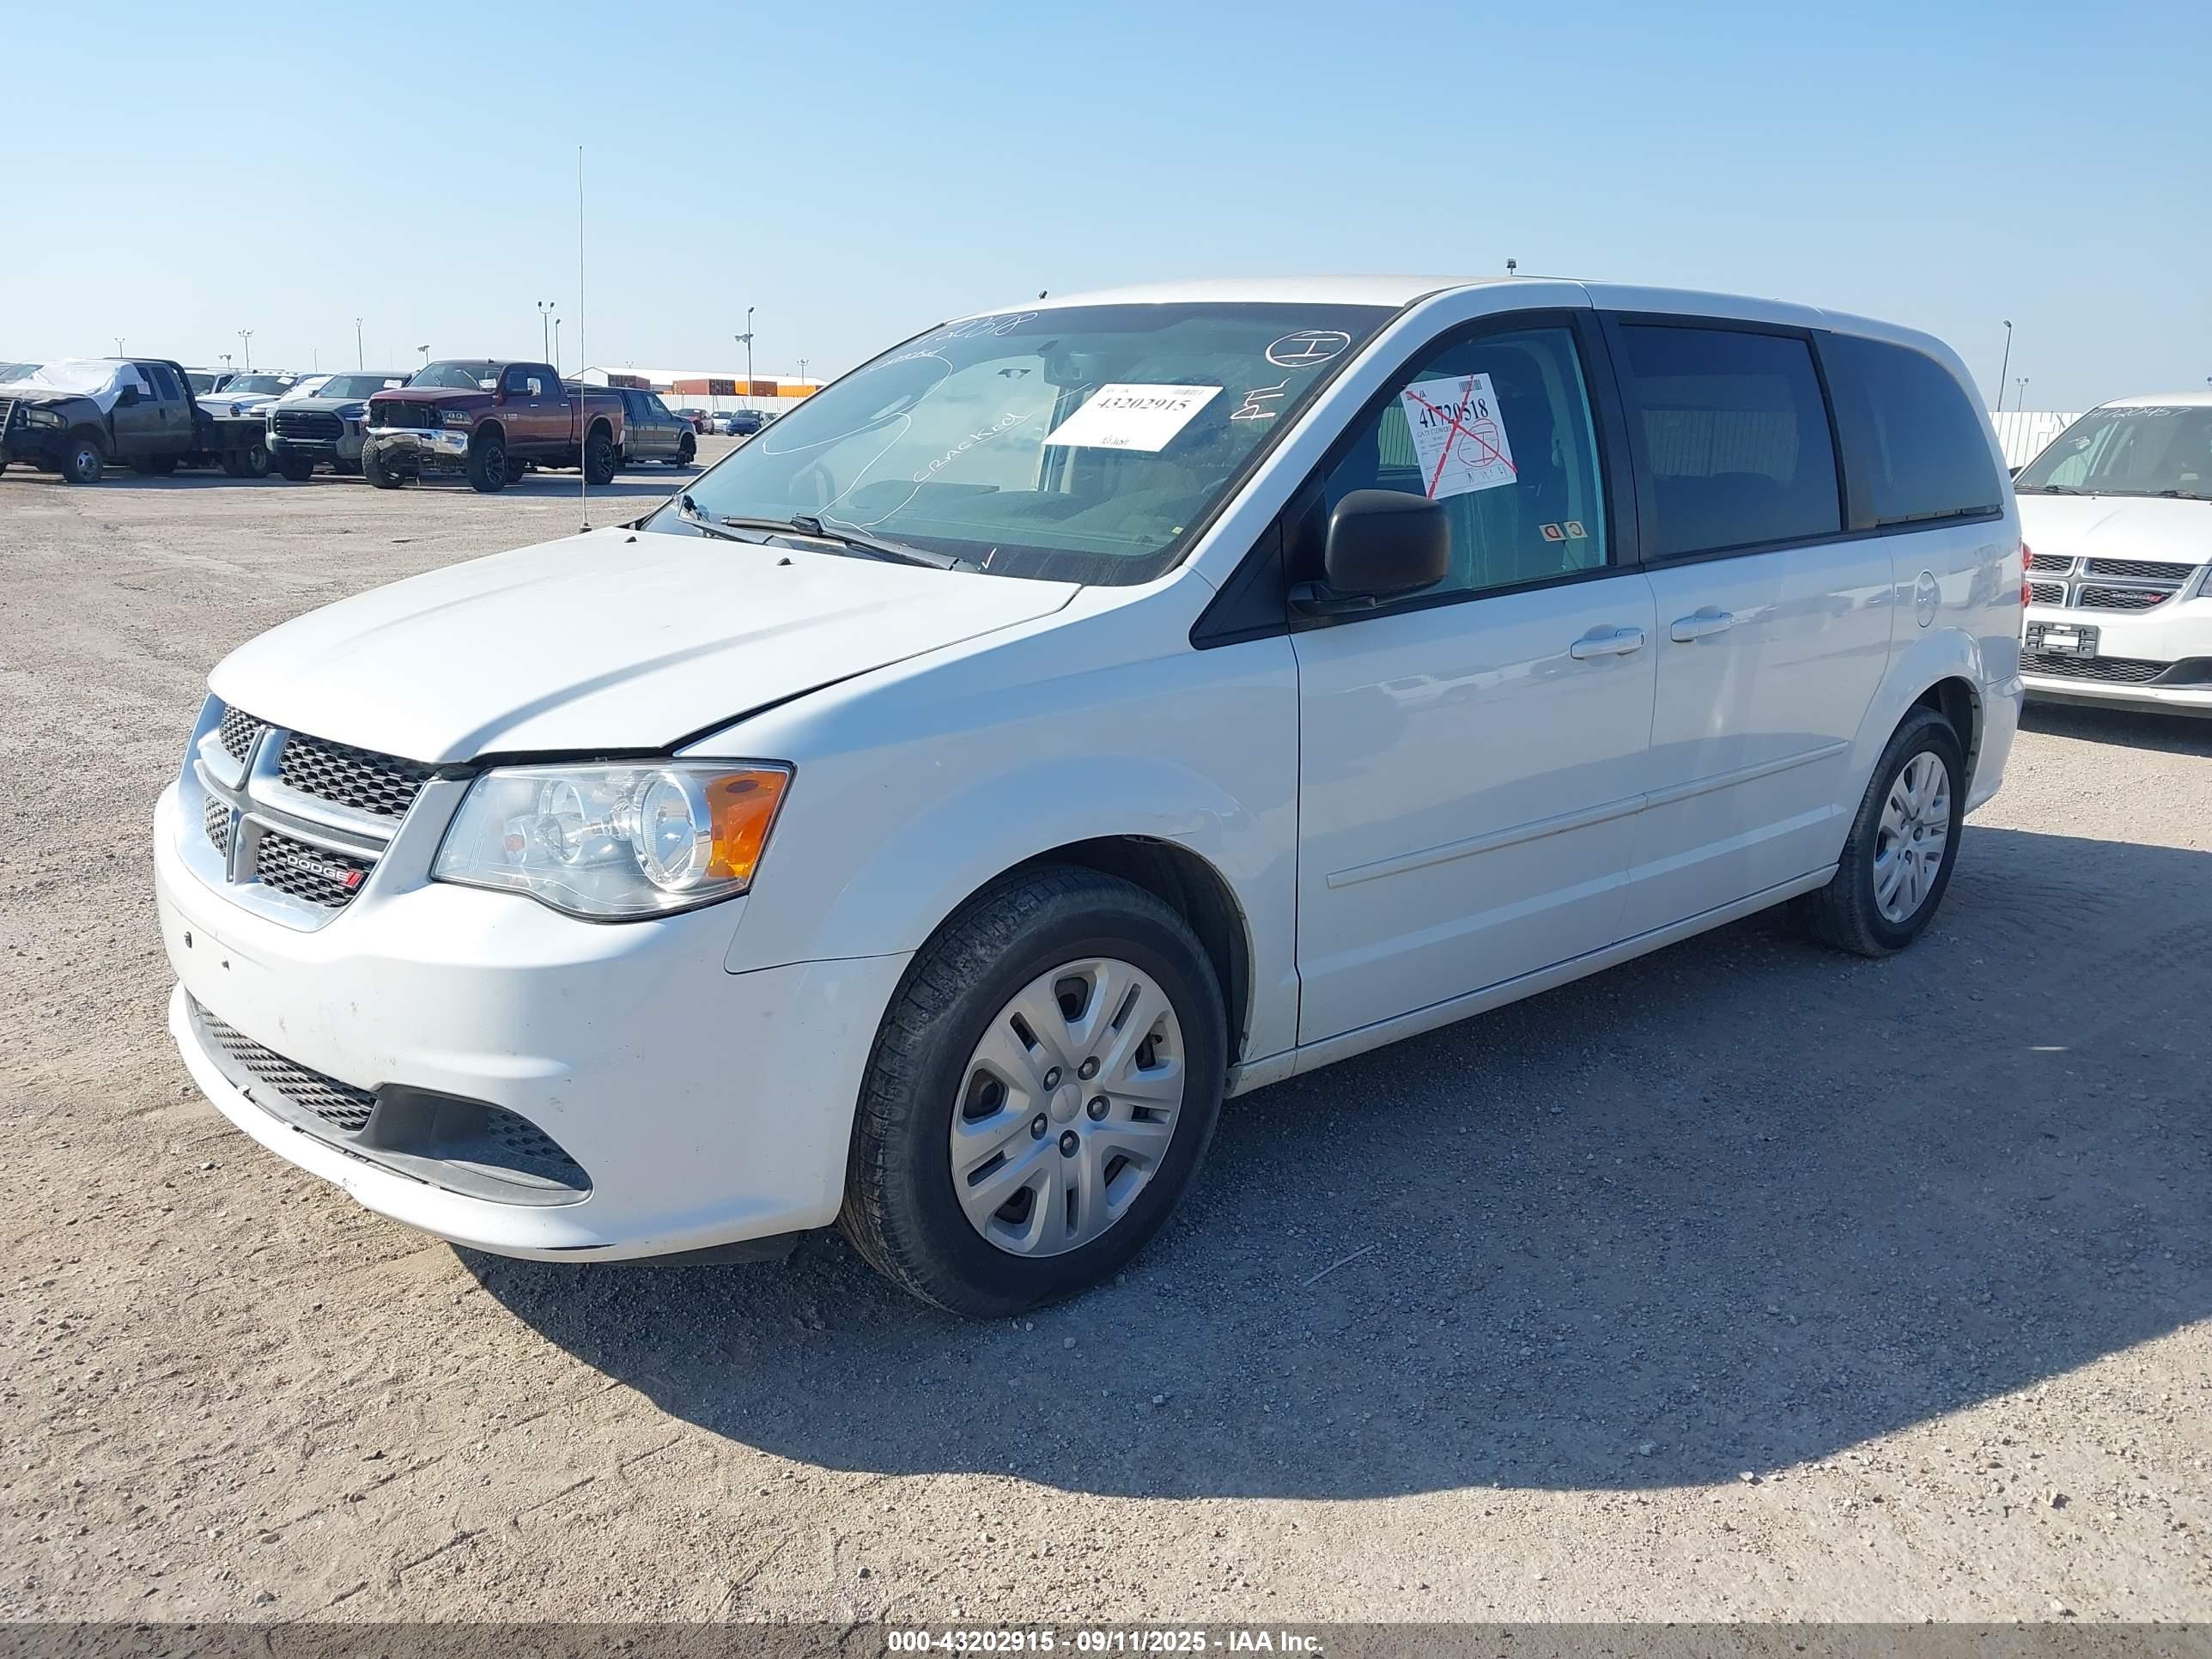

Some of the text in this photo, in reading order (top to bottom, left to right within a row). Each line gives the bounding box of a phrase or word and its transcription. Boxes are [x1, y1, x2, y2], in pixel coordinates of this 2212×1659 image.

[1097, 398, 1192, 411] 43202915
[1419, 398, 1489, 428] 41720518
[287, 854, 349, 882] DODGE
